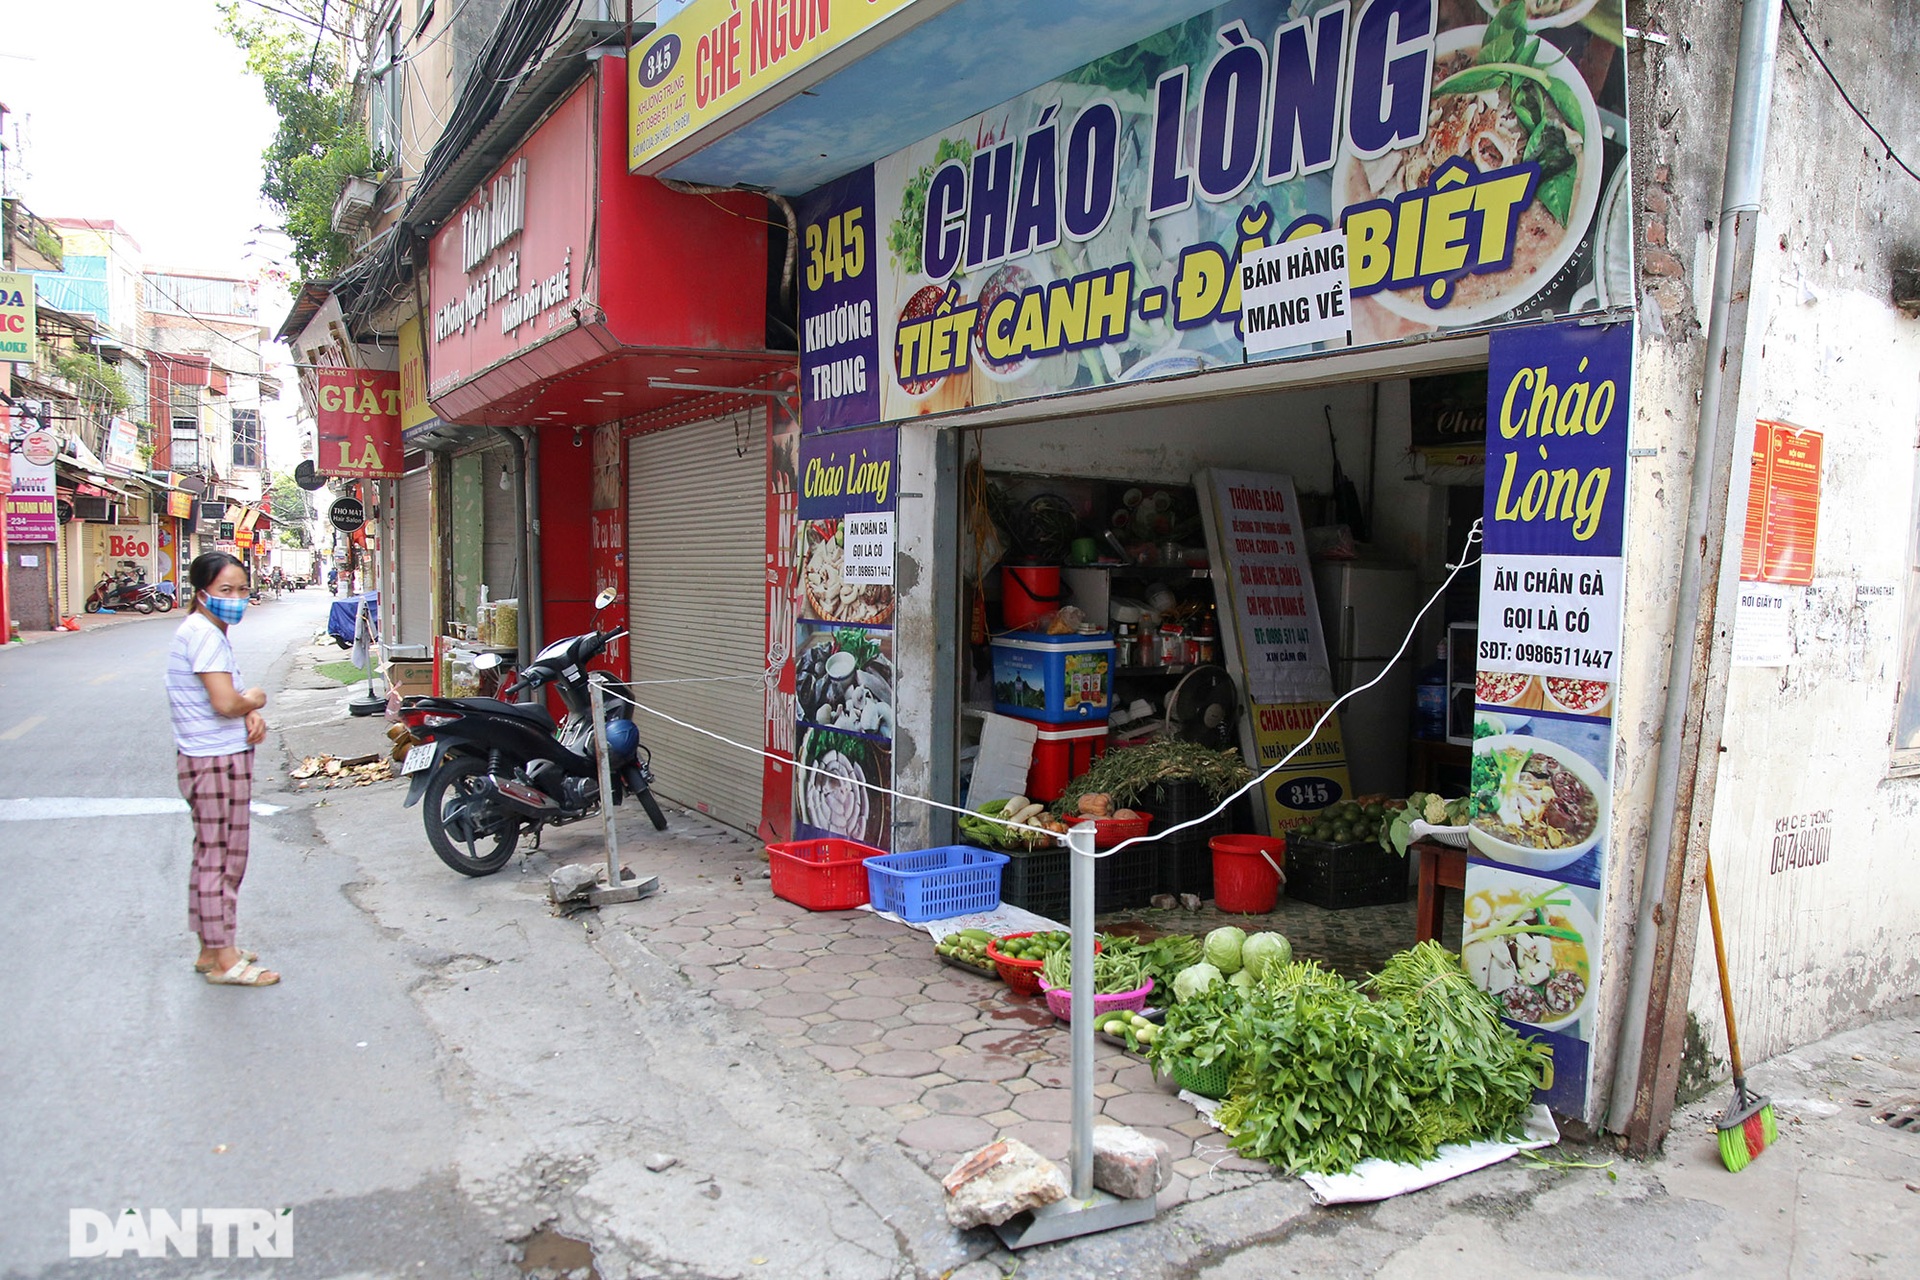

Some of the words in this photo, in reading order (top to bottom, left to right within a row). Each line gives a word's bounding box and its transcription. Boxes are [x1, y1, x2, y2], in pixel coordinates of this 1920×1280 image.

[647, 42, 671, 80] 345
[695, 0, 742, 109] CHÈ
[663, 75, 685, 98] TRUNG
[661, 103, 673, 121] 511
[674, 93, 686, 111] 447
[923, 98, 1121, 283] CHÁO
[1148, 0, 1436, 218] LÒNG
[492, 157, 527, 251] Nail
[805, 206, 865, 291] 345
[488, 250, 520, 304] Thuật
[896, 282, 981, 381] TIẾT
[983, 266, 1133, 362] CANH
[1346, 166, 1533, 300] BIỆT
[1242, 257, 1281, 290] BÁN
[1286, 244, 1345, 280] HÀNG
[1247, 298, 1309, 335] MANG
[1315, 280, 1345, 320] VỀ
[805, 299, 872, 353] KHƯƠNG
[811, 355, 866, 401] TRUNG
[319, 378, 400, 422] GIẶT
[1499, 356, 1616, 439] Cháo
[338, 434, 384, 469] LÀ
[804, 452, 845, 499] Cháo
[846, 448, 890, 504] Lòng
[1229, 484, 1263, 510] THÔNG
[1262, 486, 1284, 512] BÁO
[1494, 444, 1611, 541] Lòng
[11, 517, 26, 525] 234
[859, 520, 878, 535] CHÂN
[878, 519, 888, 535] GÀ
[109, 535, 149, 557] Béo
[852, 545, 864, 561] GỌI
[864, 544, 873, 558] LÀ
[873, 543, 883, 557] CÓ
[1256, 539, 1279, 553] COVID
[1285, 541, 1296, 555] 19
[858, 565, 891, 578] 0986511447
[1493, 566, 1518, 592] ĂN
[1523, 568, 1573, 594] CHÂN
[1579, 569, 1604, 596] GÀ
[1742, 595, 1755, 607] RƠI
[1503, 607, 1532, 633] GỌI
[1538, 605, 1558, 631] LÀ
[1565, 607, 1590, 633] CÓ
[1283, 628, 1296, 644] 511
[1297, 628, 1310, 644] 447
[1266, 652, 1279, 662] XIN
[1479, 641, 1511, 660] SĐT:
[1515, 644, 1613, 669] 0986511447
[1259, 704, 1286, 732] CHÂN
[1286, 706, 1301, 731] GÀ
[1315, 739, 1340, 755] HÀNG
[1291, 783, 1329, 804] 345
